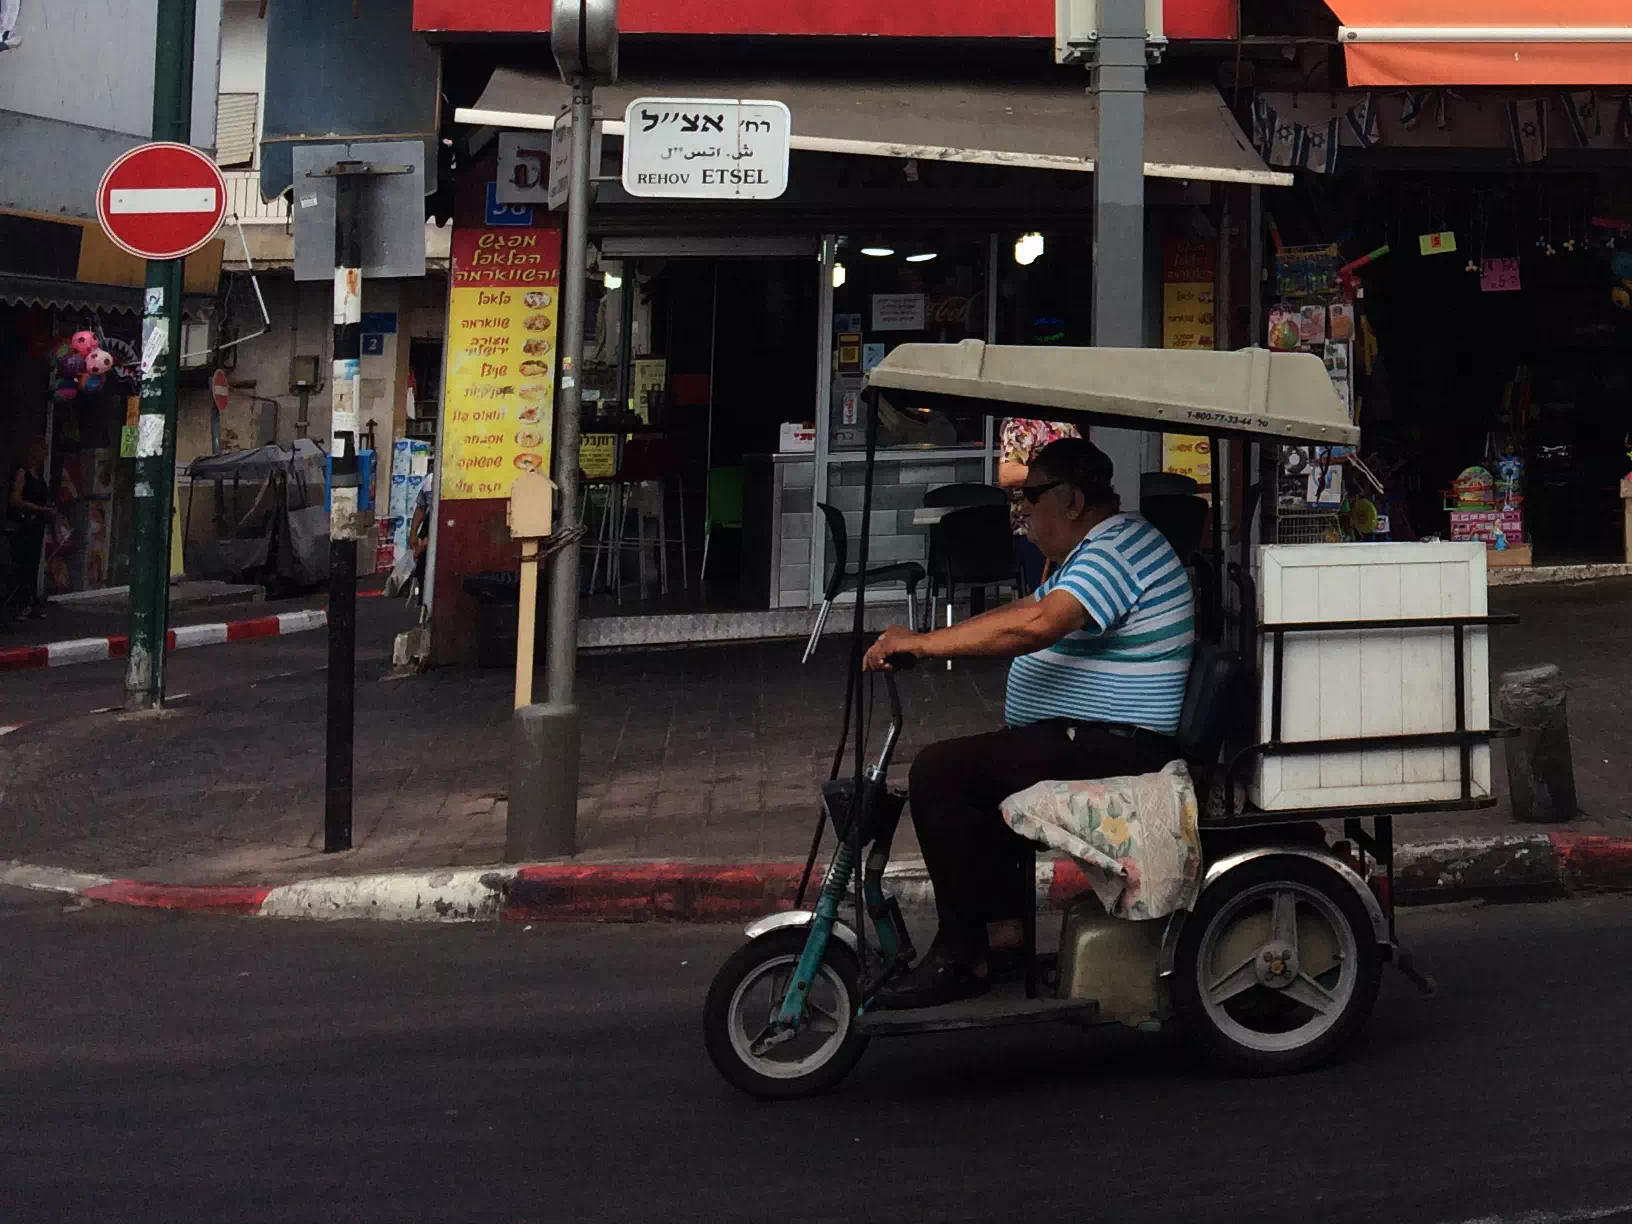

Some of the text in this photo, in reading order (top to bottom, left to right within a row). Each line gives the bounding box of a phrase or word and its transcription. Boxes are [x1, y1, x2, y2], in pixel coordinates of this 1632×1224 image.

[637, 168, 769, 185] REHOV ETSEL
[478, 232, 537, 250] מפגש
[471, 249, 542, 266] הפלאפל
[478, 290, 511, 306] פלאפל
[460, 317, 511, 330] שווארמה
[368, 338, 378, 351] 2
